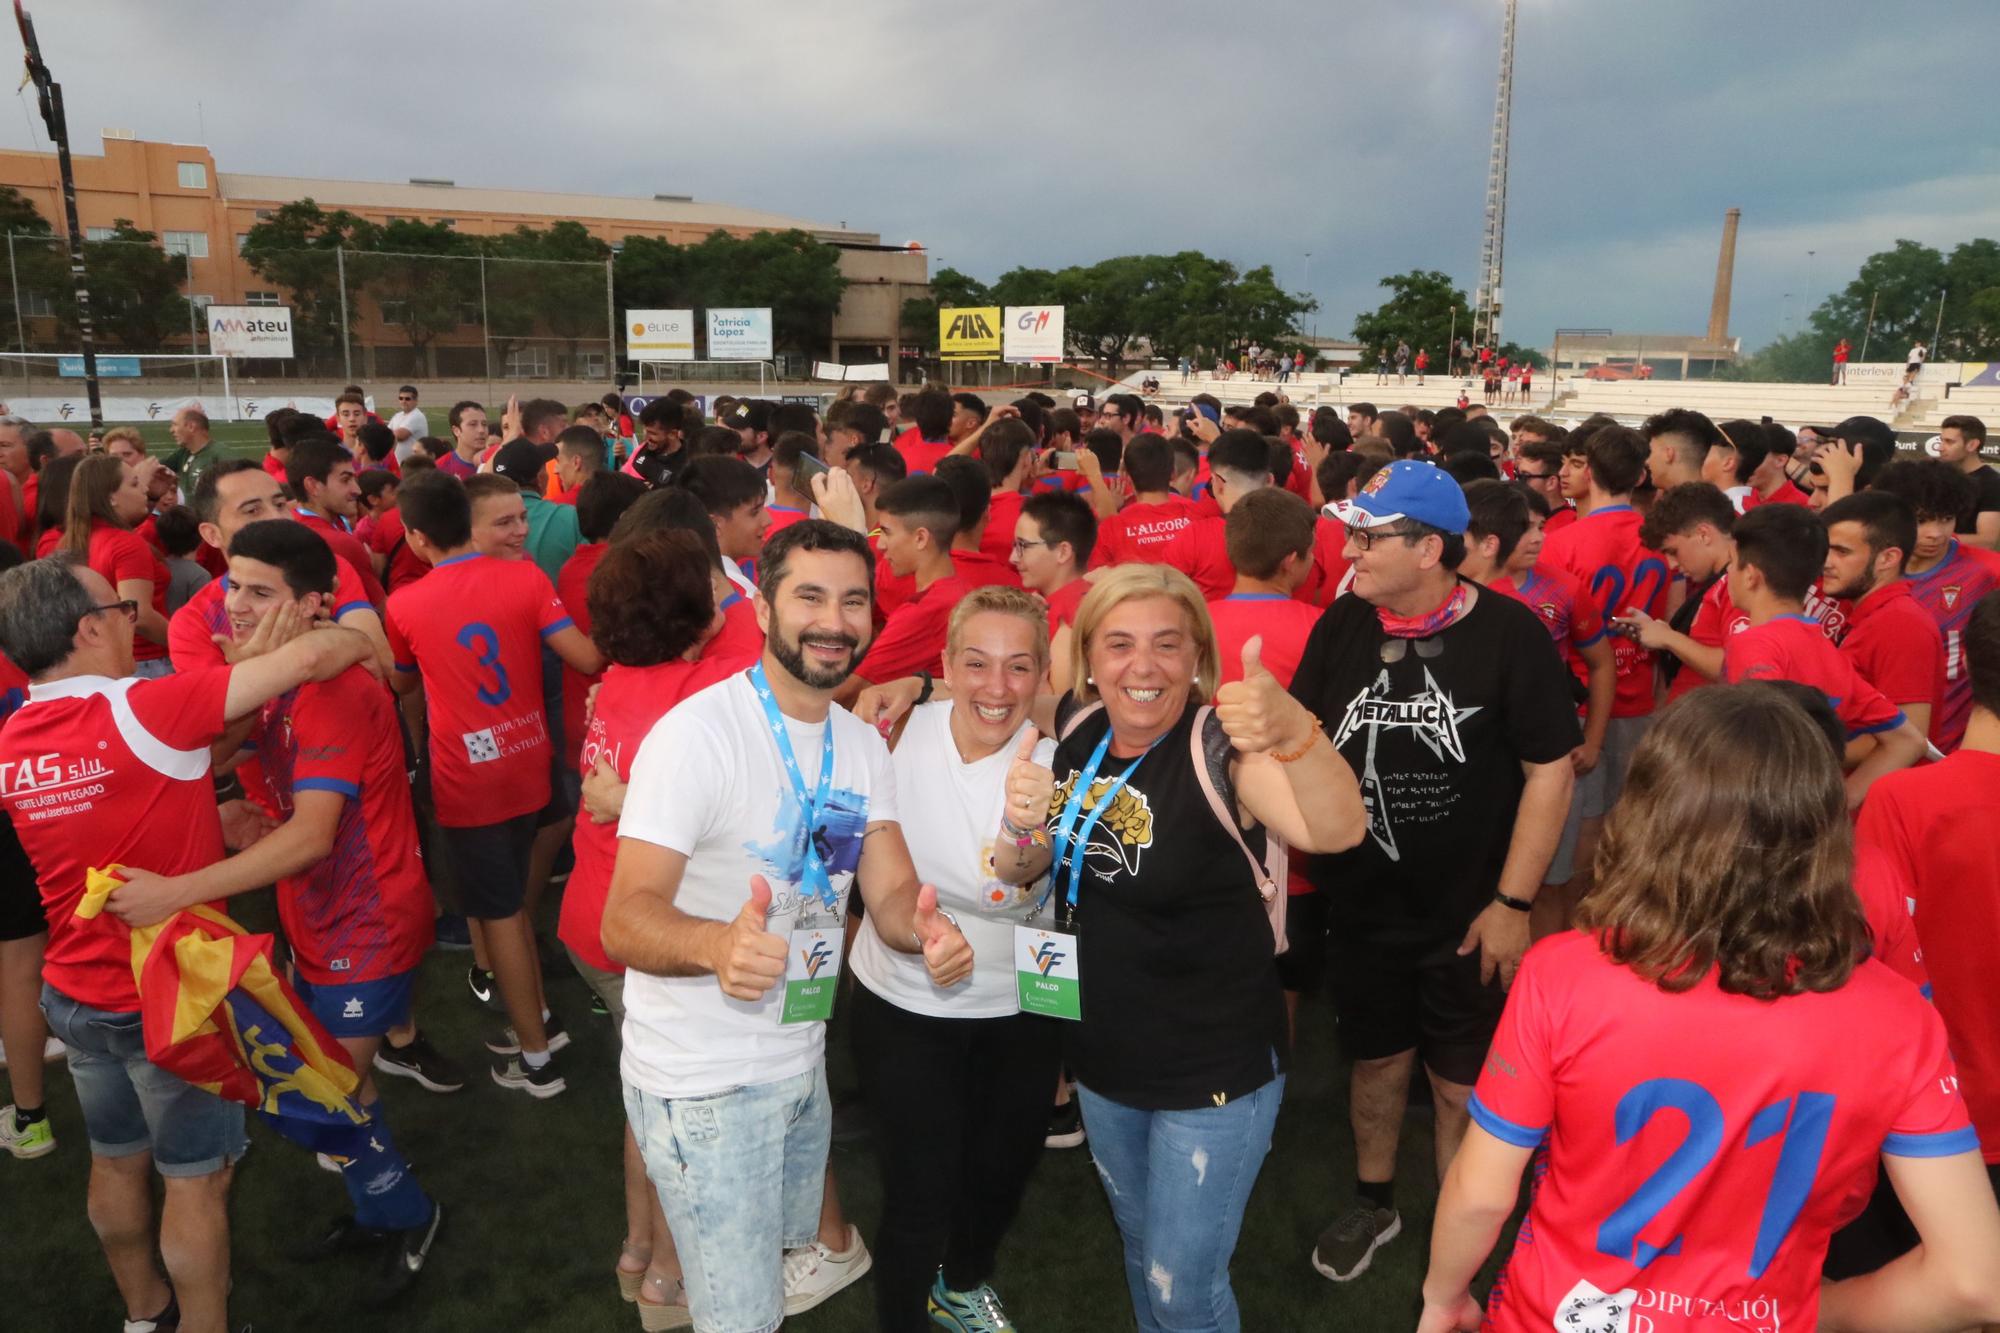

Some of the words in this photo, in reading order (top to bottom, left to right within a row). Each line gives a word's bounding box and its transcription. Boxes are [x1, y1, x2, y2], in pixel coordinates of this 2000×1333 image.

[945, 314, 994, 339] FILA
[1846, 366, 1894, 377] interleva
[456, 621, 512, 706] 3
[1333, 687, 1467, 764] METALLICA
[62, 783, 105, 802] PLEGADO
[28, 801, 93, 821] www.lasertas.com
[1035, 981, 1059, 992] PALCO
[1596, 1077, 1837, 1280] 21
